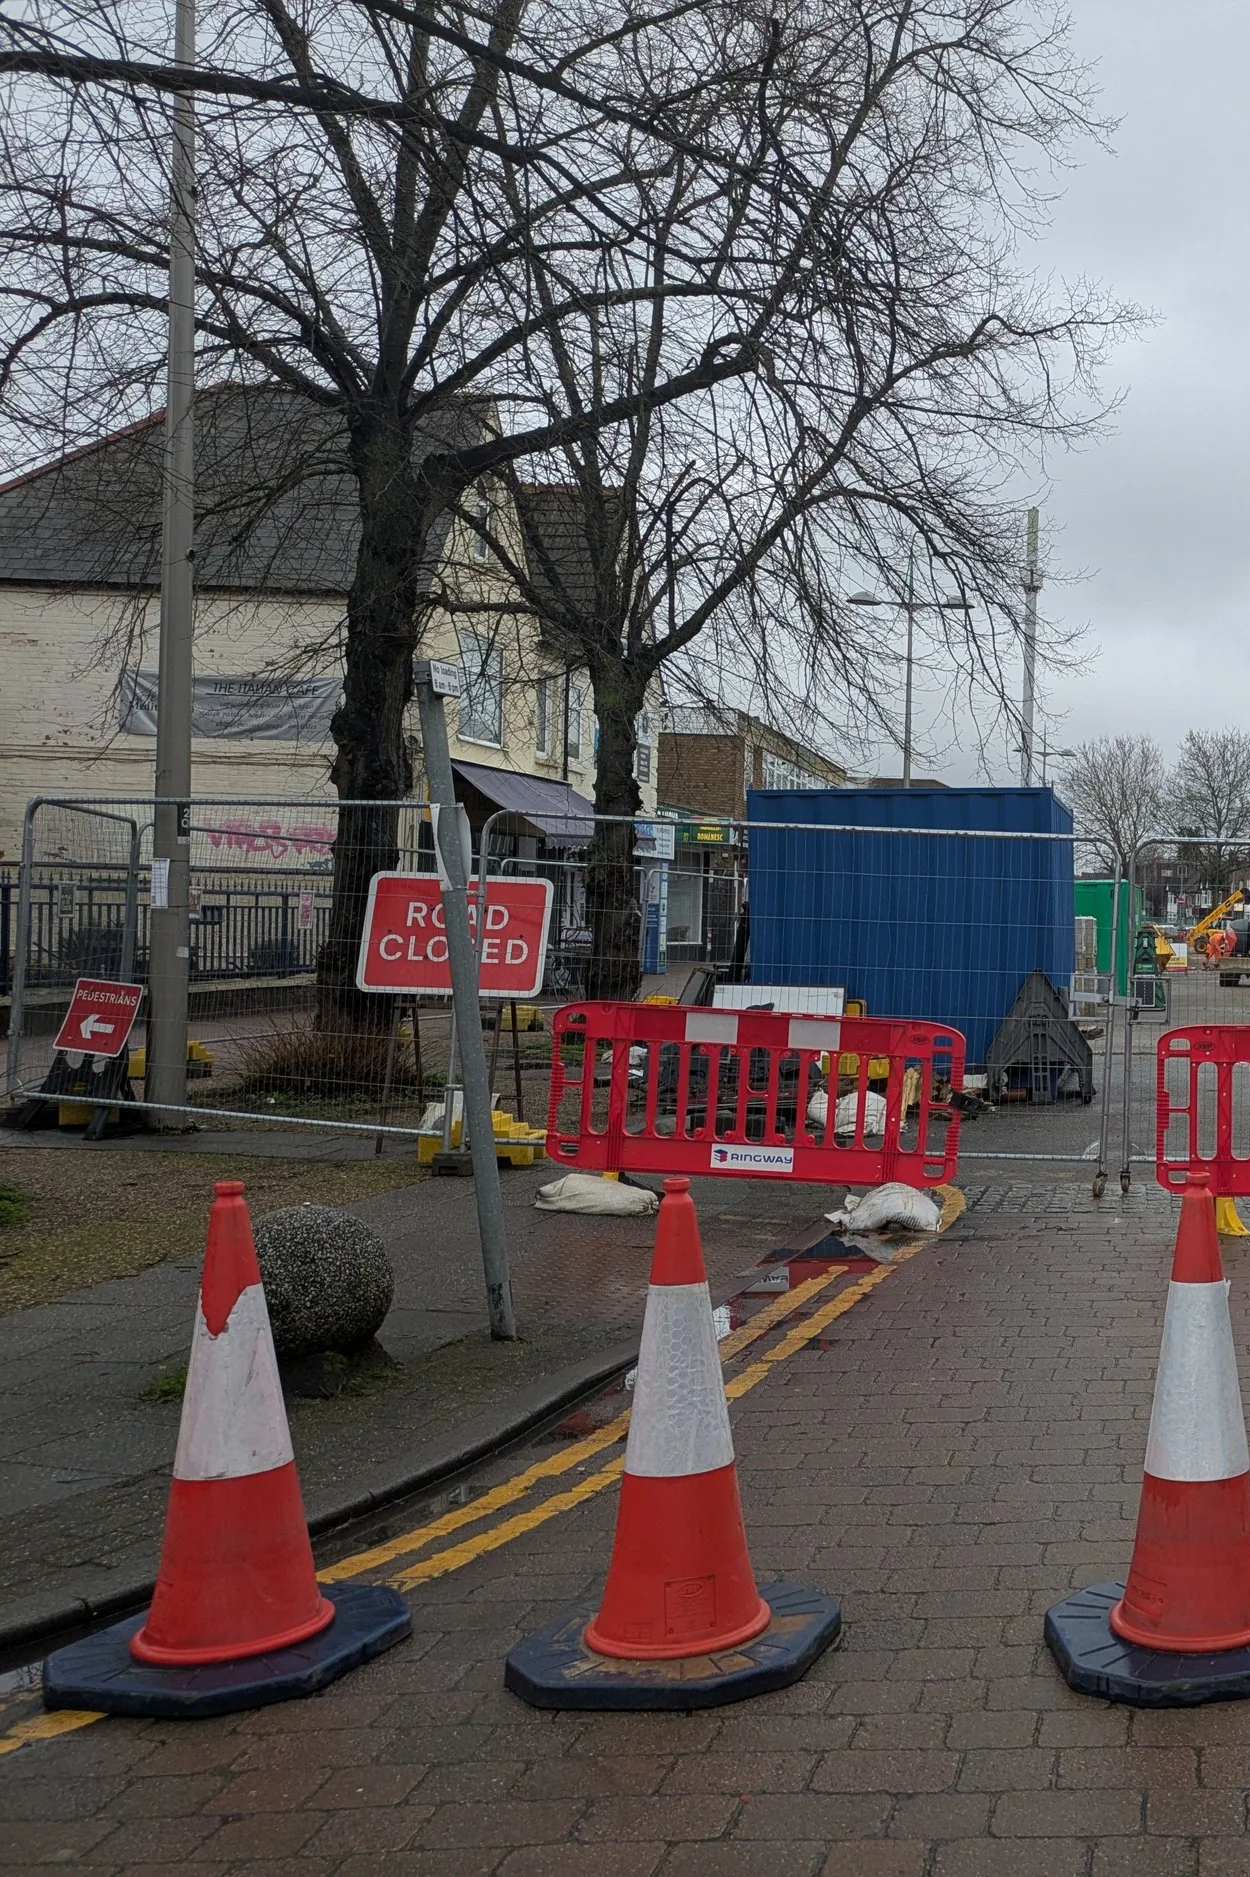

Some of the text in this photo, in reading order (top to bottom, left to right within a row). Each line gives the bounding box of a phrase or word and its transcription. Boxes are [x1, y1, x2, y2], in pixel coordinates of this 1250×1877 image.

[433, 664, 457, 679] No loading
[213, 682, 234, 694] THE
[238, 682, 282, 695] ITALIAN
[379, 934, 528, 964] CLOED
[77, 990, 137, 1006] PEDESTRIANS
[731, 1152, 792, 1164] RINGWAY
